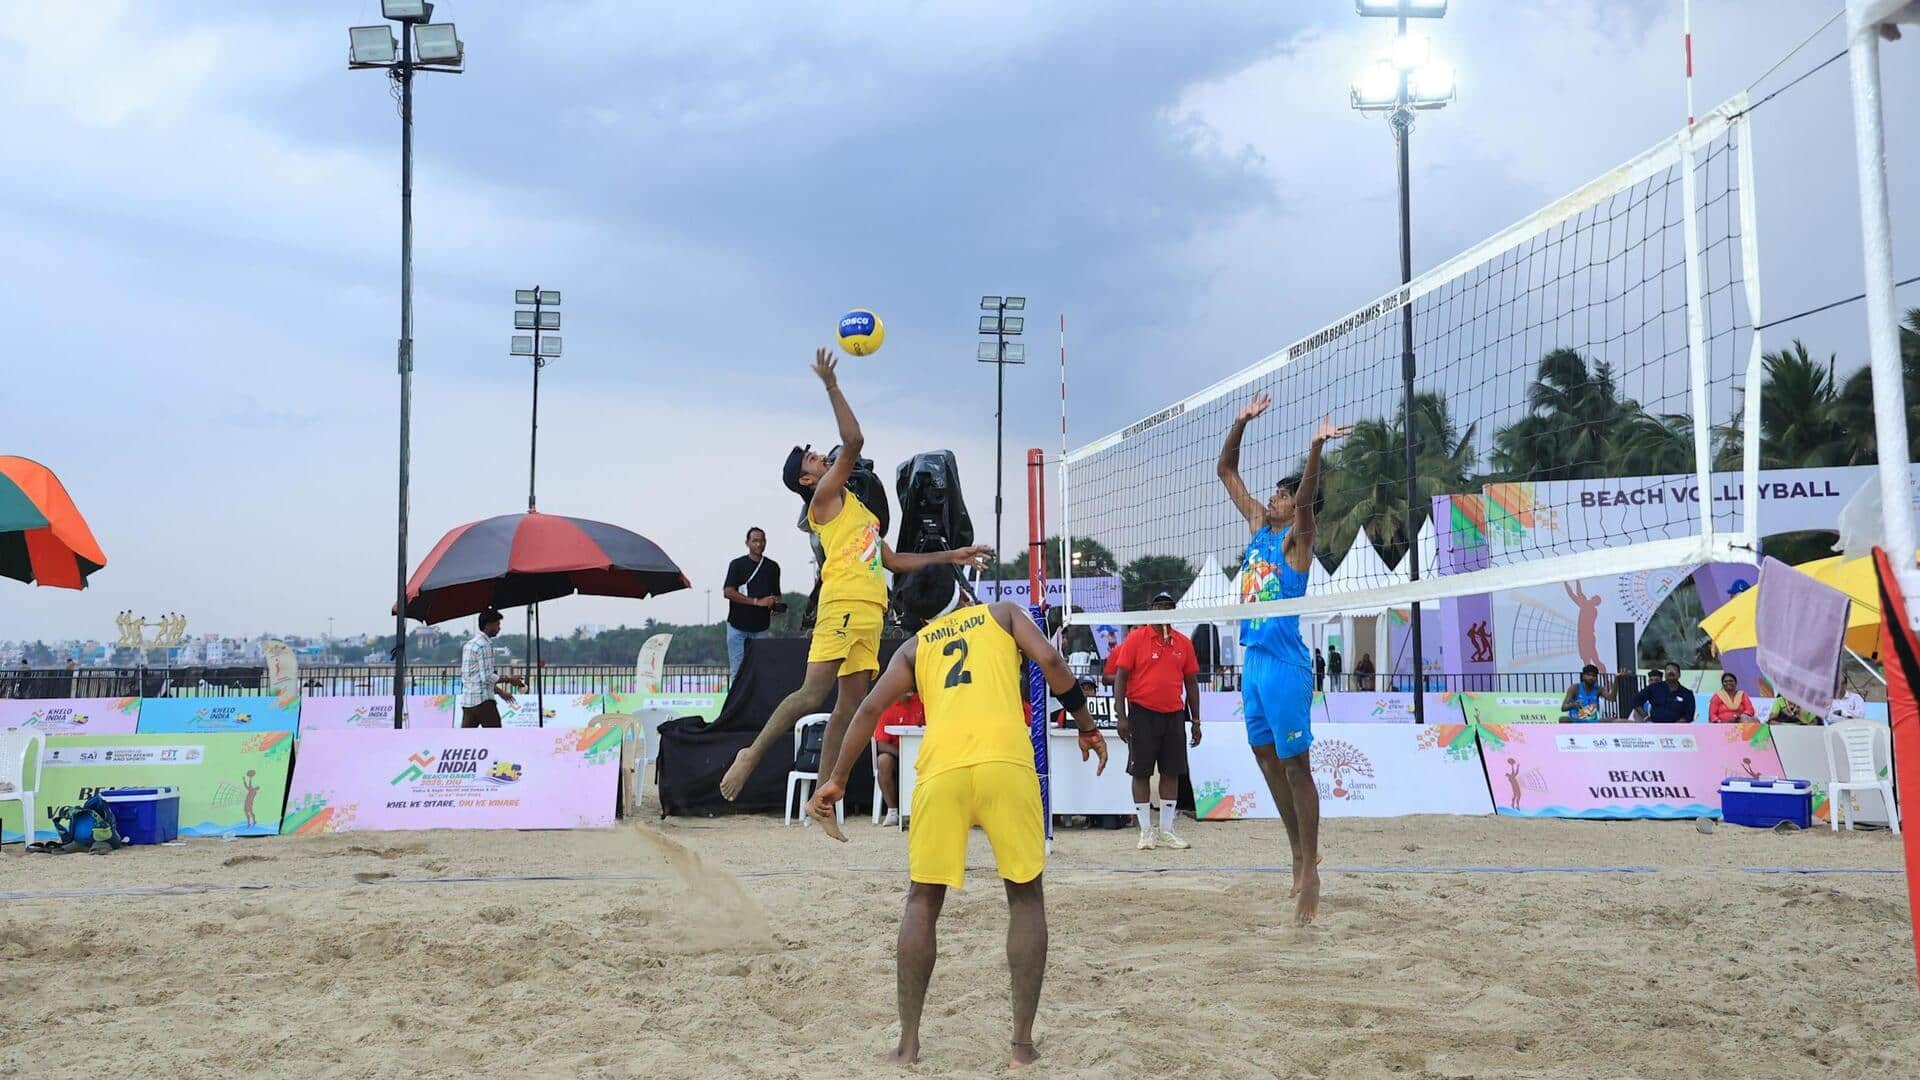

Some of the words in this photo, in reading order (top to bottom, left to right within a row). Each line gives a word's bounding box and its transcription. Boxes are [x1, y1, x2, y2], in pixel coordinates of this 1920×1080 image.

[1306, 330, 1328, 351] INDIA
[1329, 319, 1354, 342] BEACH
[1354, 304, 1380, 328] GAMES
[1580, 488, 1664, 508] BEACH
[1671, 480, 1840, 503] VOLYBALL
[842, 612, 851, 628] 1
[923, 627, 958, 644] TAMIL
[943, 638, 972, 690] 2
[80, 751, 98, 760] SAI
[441, 748, 488, 760] KHELO
[437, 762, 477, 773] INDIA
[1608, 770, 1666, 782] BEACH
[1348, 778, 1376, 790] daman
[1588, 786, 1696, 798] VOLLEYBALL
